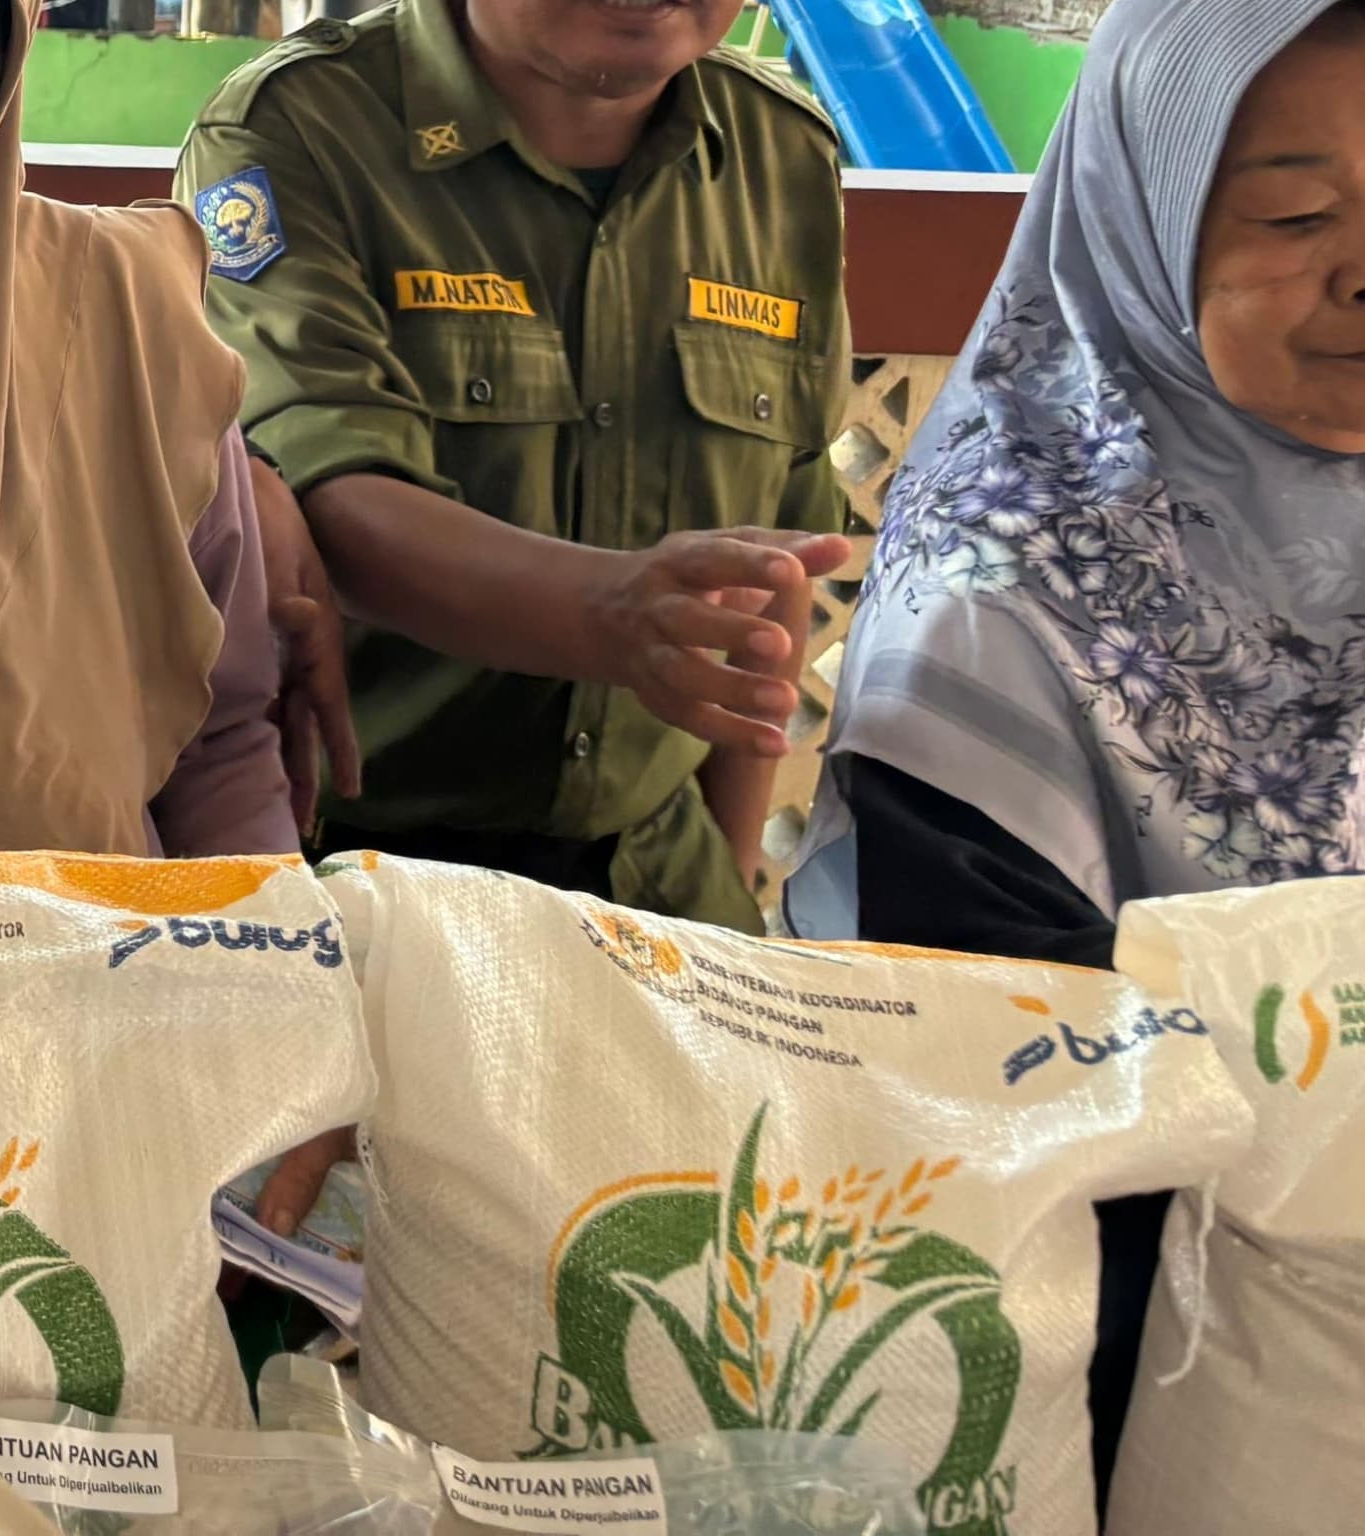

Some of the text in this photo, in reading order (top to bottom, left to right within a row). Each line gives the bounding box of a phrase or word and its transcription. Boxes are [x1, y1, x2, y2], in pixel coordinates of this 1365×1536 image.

[705, 286, 781, 329] LINMAS
[696, 979, 824, 1034] BIDANG PANGAN
[797, 991, 917, 1016] KOORDINATOR
[773, 1035, 863, 1067] INDONESIA
[69, 1445, 159, 1469] PANGAN
[17, 1471, 56, 1487] Untuk
[59, 1474, 162, 1495] Diperjualbelikan
[453, 1465, 653, 1498] BANTUAN PANGAN
[513, 1504, 557, 1520] Untuk
